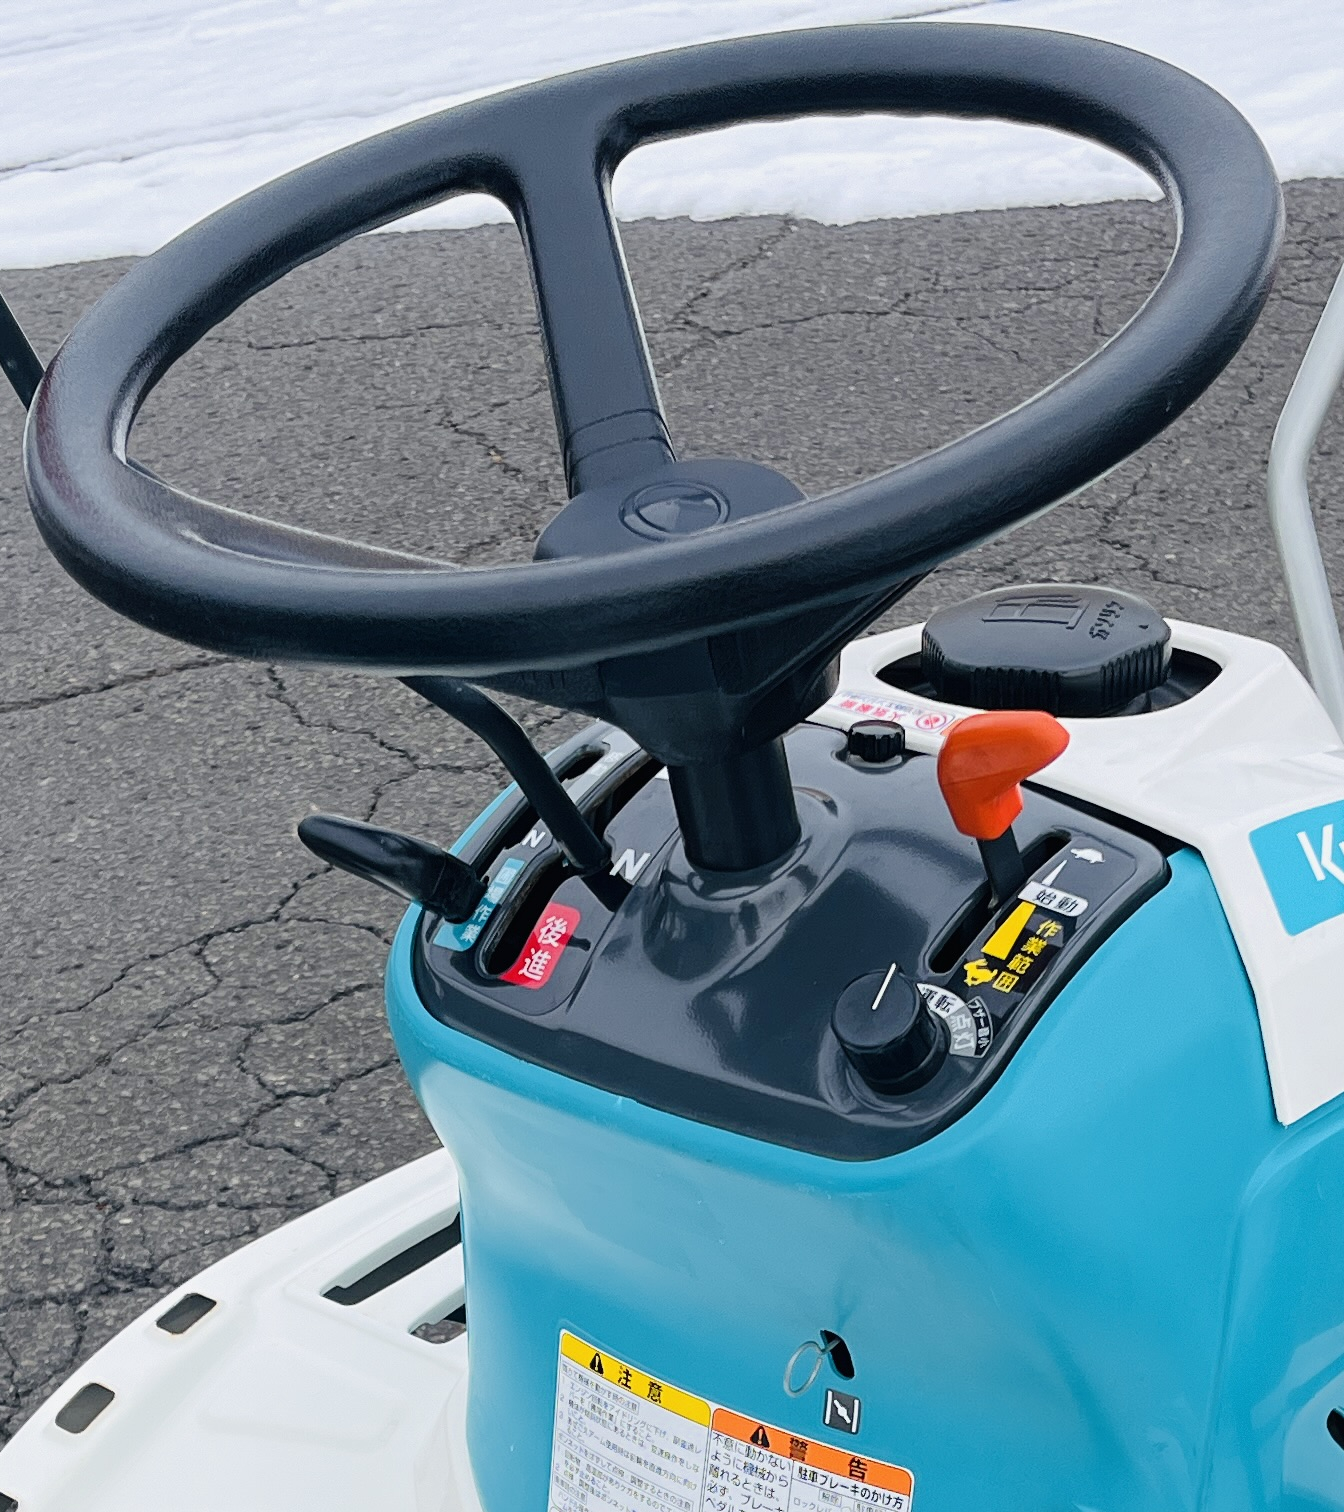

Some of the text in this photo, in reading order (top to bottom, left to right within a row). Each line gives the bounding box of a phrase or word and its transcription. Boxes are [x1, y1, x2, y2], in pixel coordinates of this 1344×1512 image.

[520, 829, 545, 848] N
[609, 849, 651, 880] N
[1036, 889, 1078, 913] 始動
[518, 915, 569, 981] 後進
[992, 919, 1062, 993] 作業範囲
[922, 986, 956, 1013] 運転
[950, 1013, 974, 1050] 点灯
[618, 1365, 662, 1404] 注意
[710, 1449, 789, 1488] ように機械から
[712, 1435, 791, 1471] 不意に動かない
[790, 1437, 868, 1483] 警告
[708, 1464, 781, 1502] 離れるときは、
[798, 1466, 904, 1510] 駐車ブレーキのかけ方
